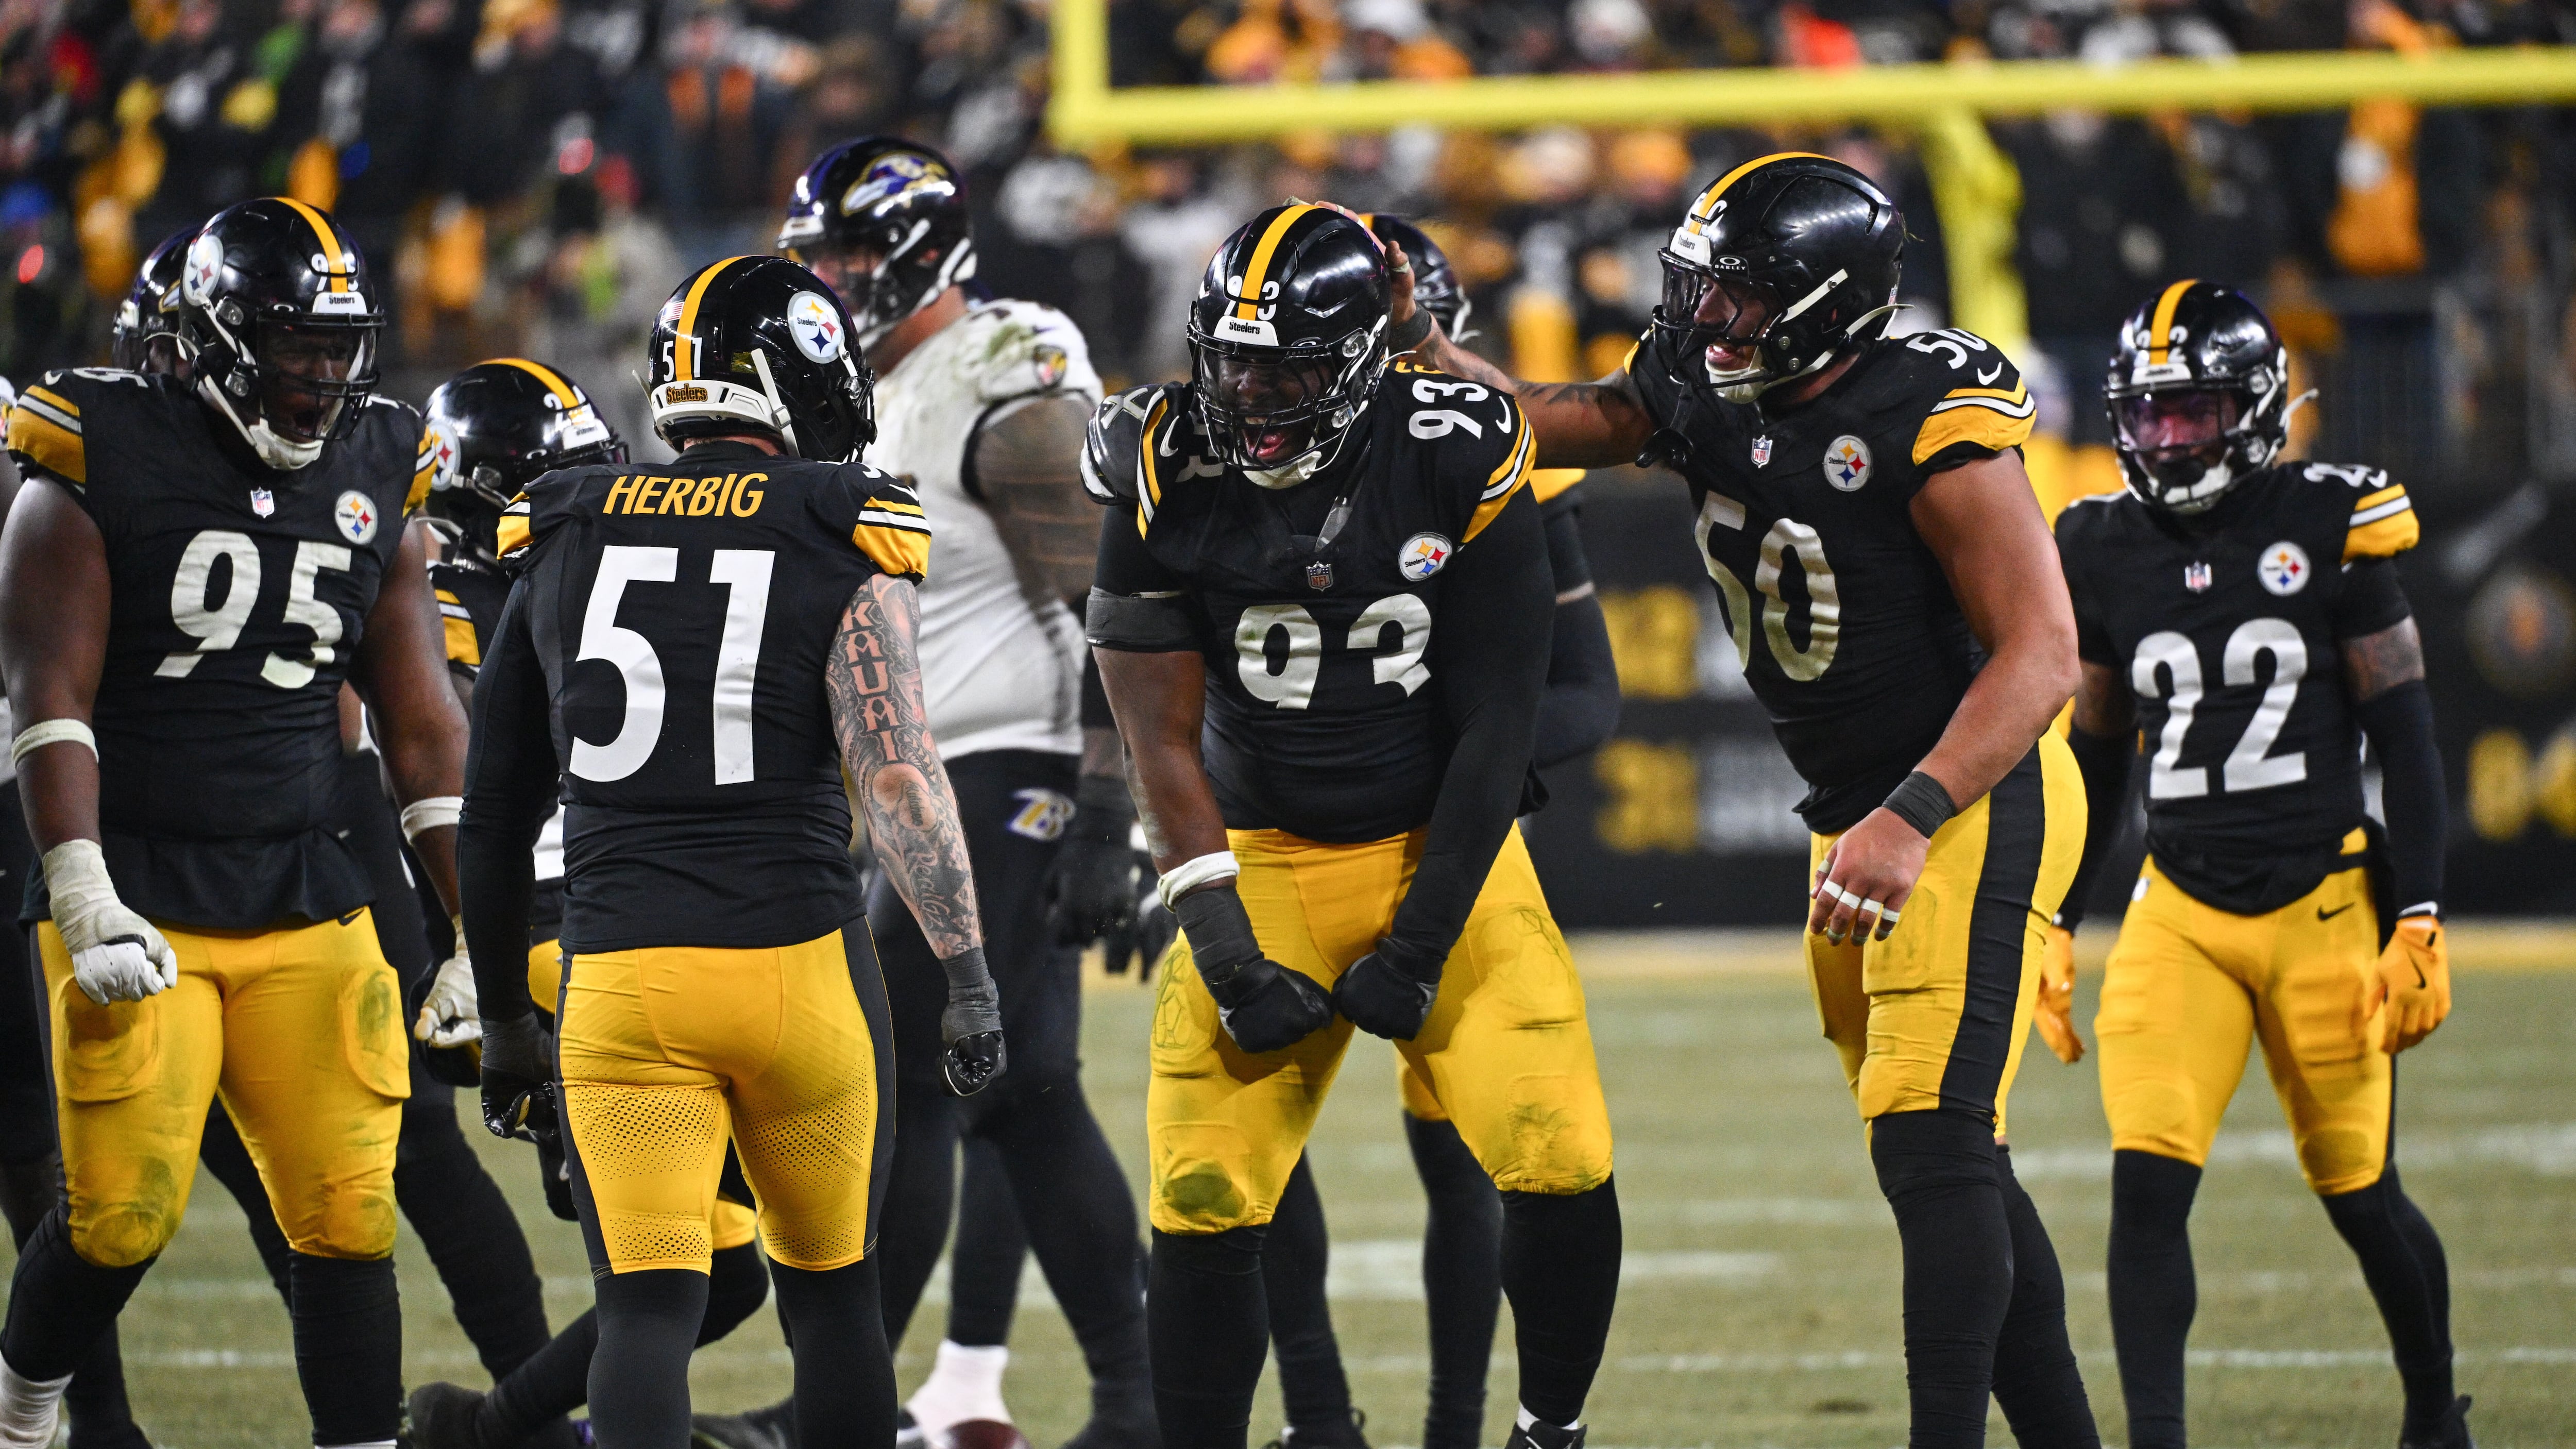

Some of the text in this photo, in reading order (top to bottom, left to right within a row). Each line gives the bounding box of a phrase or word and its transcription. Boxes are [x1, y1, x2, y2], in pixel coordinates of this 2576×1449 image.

[311, 253, 359, 292] 95
[329, 294, 354, 305] Steelers
[1224, 275, 1280, 321] 93
[796, 317, 817, 327] Steelers
[1229, 321, 1260, 334] Steelers
[663, 337, 702, 382] 51
[1906, 328, 1987, 369] 50
[666, 383, 708, 405] Steelers
[1409, 379, 1488, 440] 93
[1754, 450, 1767, 462] NFL
[1828, 457, 1847, 466] Steelers
[603, 473, 769, 517] HERBIG
[1311, 575, 1330, 586] NFL
[1405, 557, 1426, 568] Steelers
[1694, 490, 1840, 682] 50
[154, 530, 352, 689] 95
[569, 545, 775, 785] 51
[1235, 594, 1431, 710] 93
[2132, 618, 2307, 800] 22
